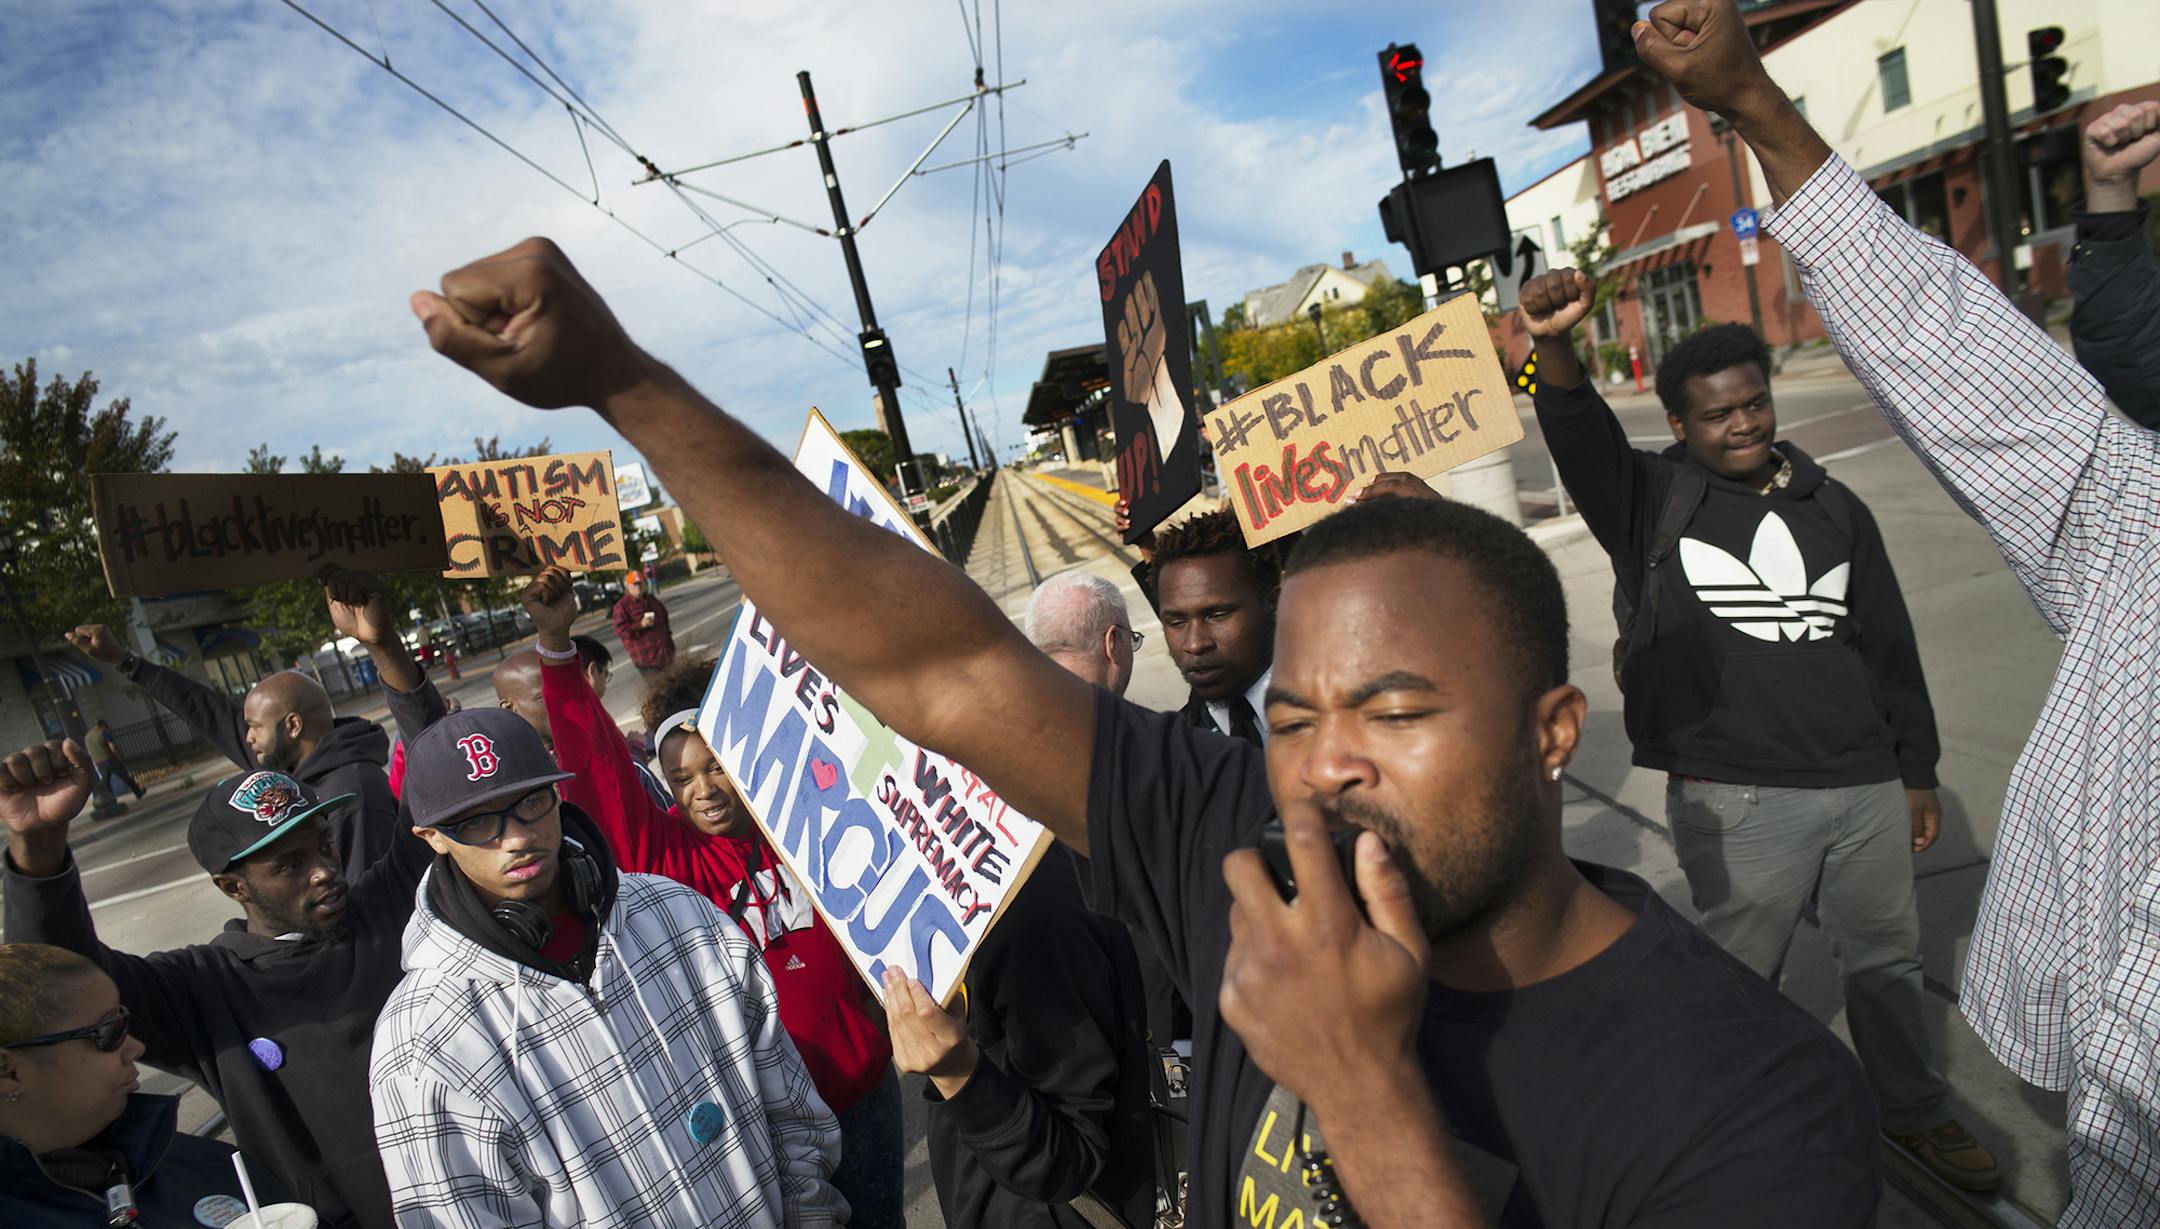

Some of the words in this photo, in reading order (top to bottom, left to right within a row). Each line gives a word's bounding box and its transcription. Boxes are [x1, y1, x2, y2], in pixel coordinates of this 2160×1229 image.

[1099, 183, 1161, 302] STAND
[1215, 322, 1475, 457] #BLACK
[437, 458, 609, 502] AUTISM
[479, 502, 510, 529] IS
[513, 496, 586, 526] NOT
[1119, 423, 1160, 509] UP!
[1234, 440, 1352, 530] lives
[1338, 388, 1482, 482] matter
[447, 520, 622, 572] CRIME
[520, 523, 533, 534] A
[749, 606, 839, 735] LIVES
[457, 733, 501, 782] B
[711, 637, 970, 994] MARCUS
[914, 747, 1011, 886] WHITE
[877, 773, 992, 927] SUPREMACY
